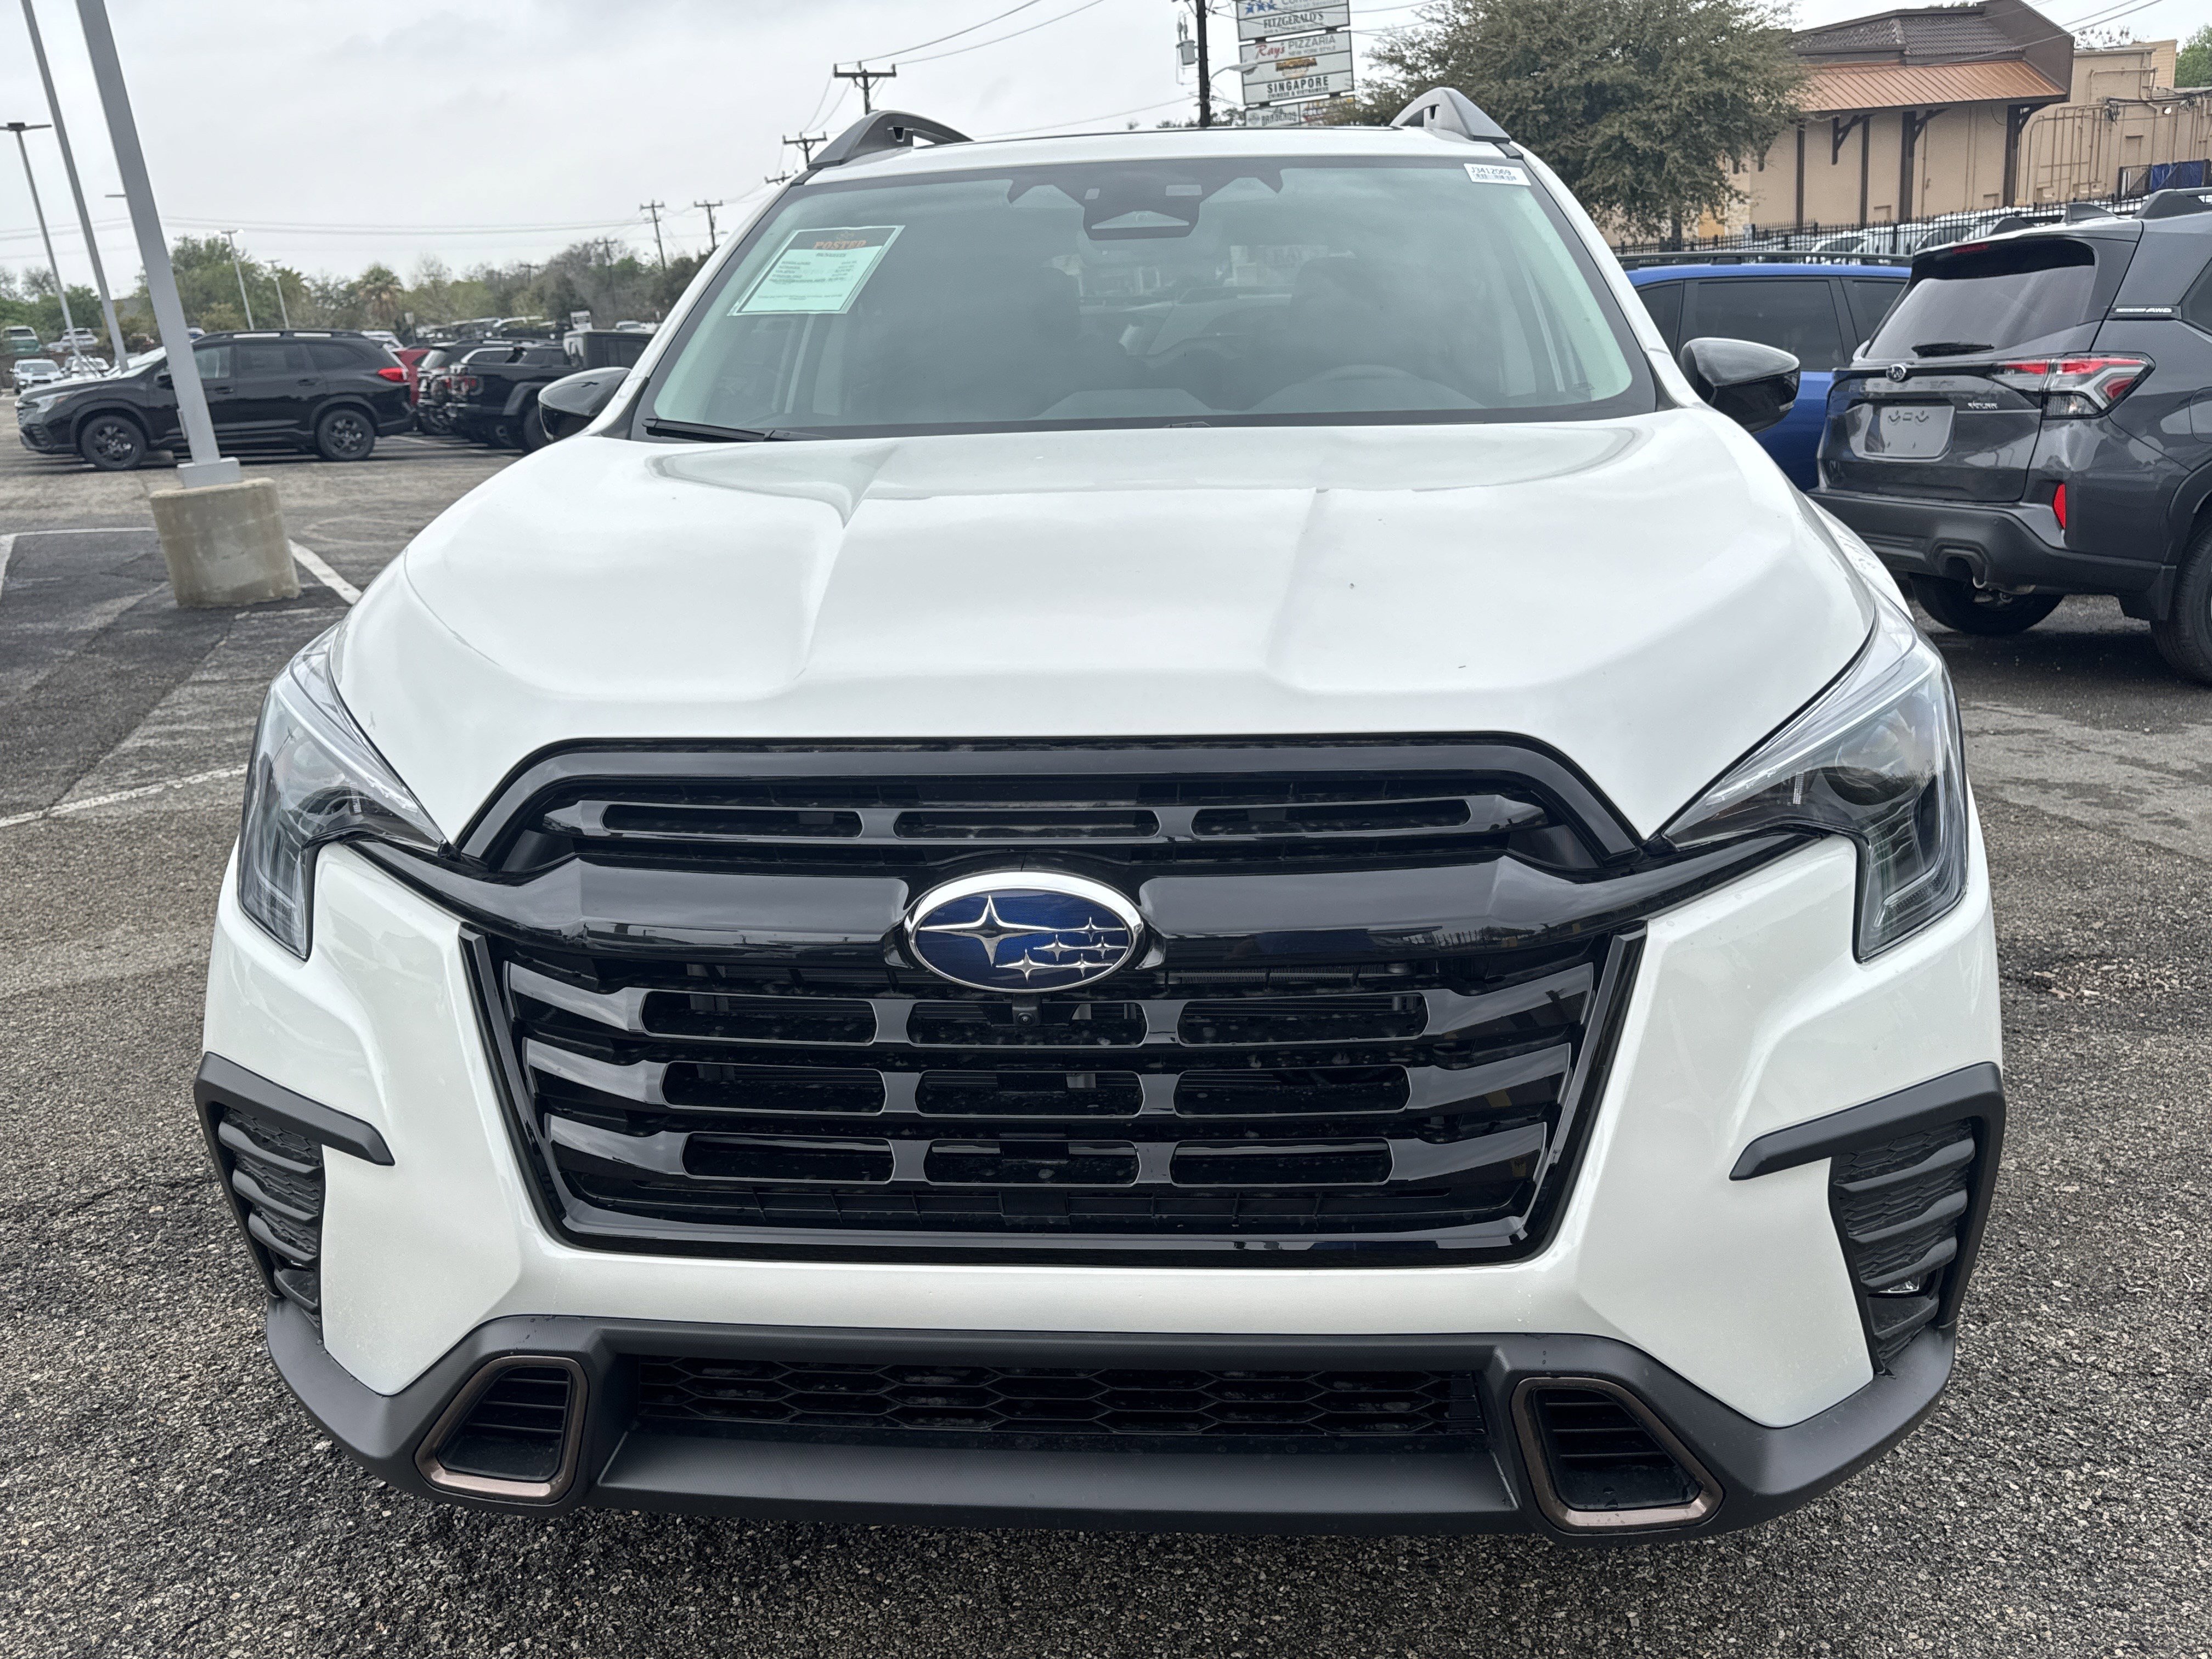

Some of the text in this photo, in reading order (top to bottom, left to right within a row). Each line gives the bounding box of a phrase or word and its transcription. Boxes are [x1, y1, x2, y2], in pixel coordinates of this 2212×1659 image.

[1263, 12, 1324, 29] FITZGERALD'S
[1255, 35, 1336, 59] Ray's PIZZARIA
[1267, 76, 1329, 94] SINGAPORE
